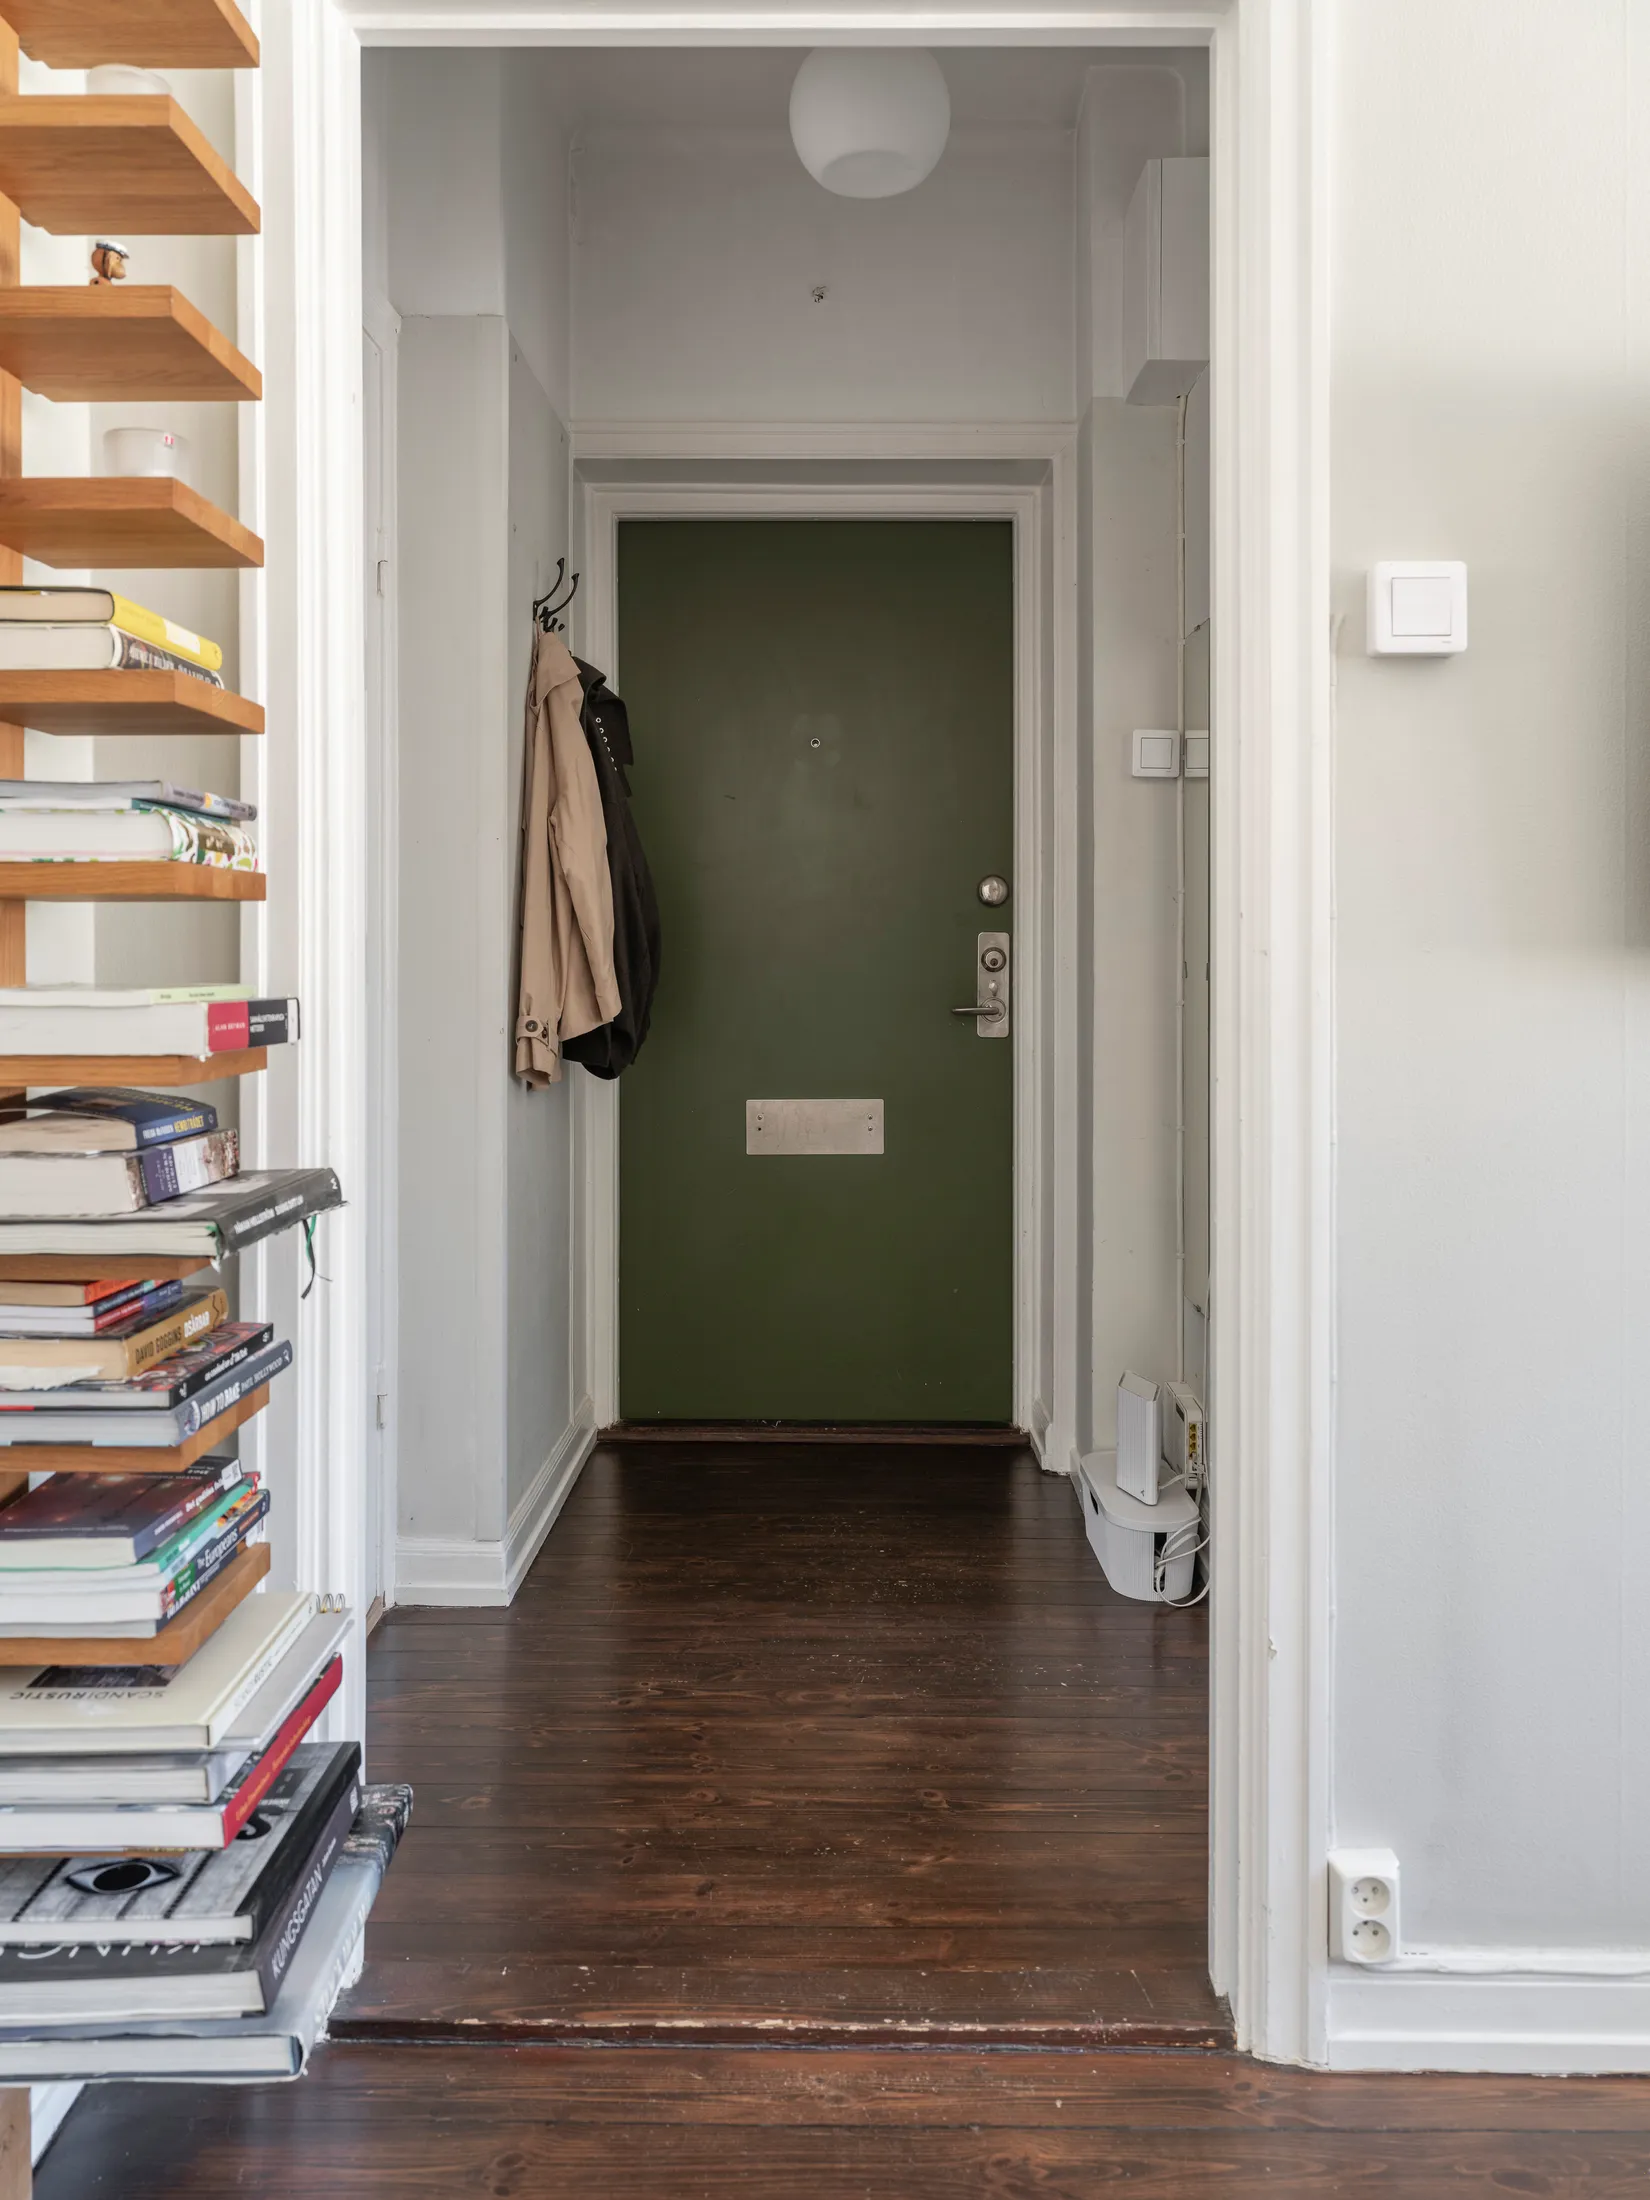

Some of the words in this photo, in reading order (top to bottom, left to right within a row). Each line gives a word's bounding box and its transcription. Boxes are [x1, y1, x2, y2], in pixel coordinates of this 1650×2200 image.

[136, 1341, 154, 1365] DAVID
[155, 1326, 182, 1353] GOGGINS
[183, 1310, 210, 1338] OSÅRBAR
[201, 1398, 217, 1424] HOW
[216, 1392, 225, 1412] TO
[223, 1382, 240, 1408] BAKE
[254, 1357, 283, 1384] HOLLYWOOD
[204, 1528, 239, 1568] Europeans
[9, 1690, 167, 1700] SCANDIRUSTIC
[271, 1866, 324, 1981] KUNGSGATAN
